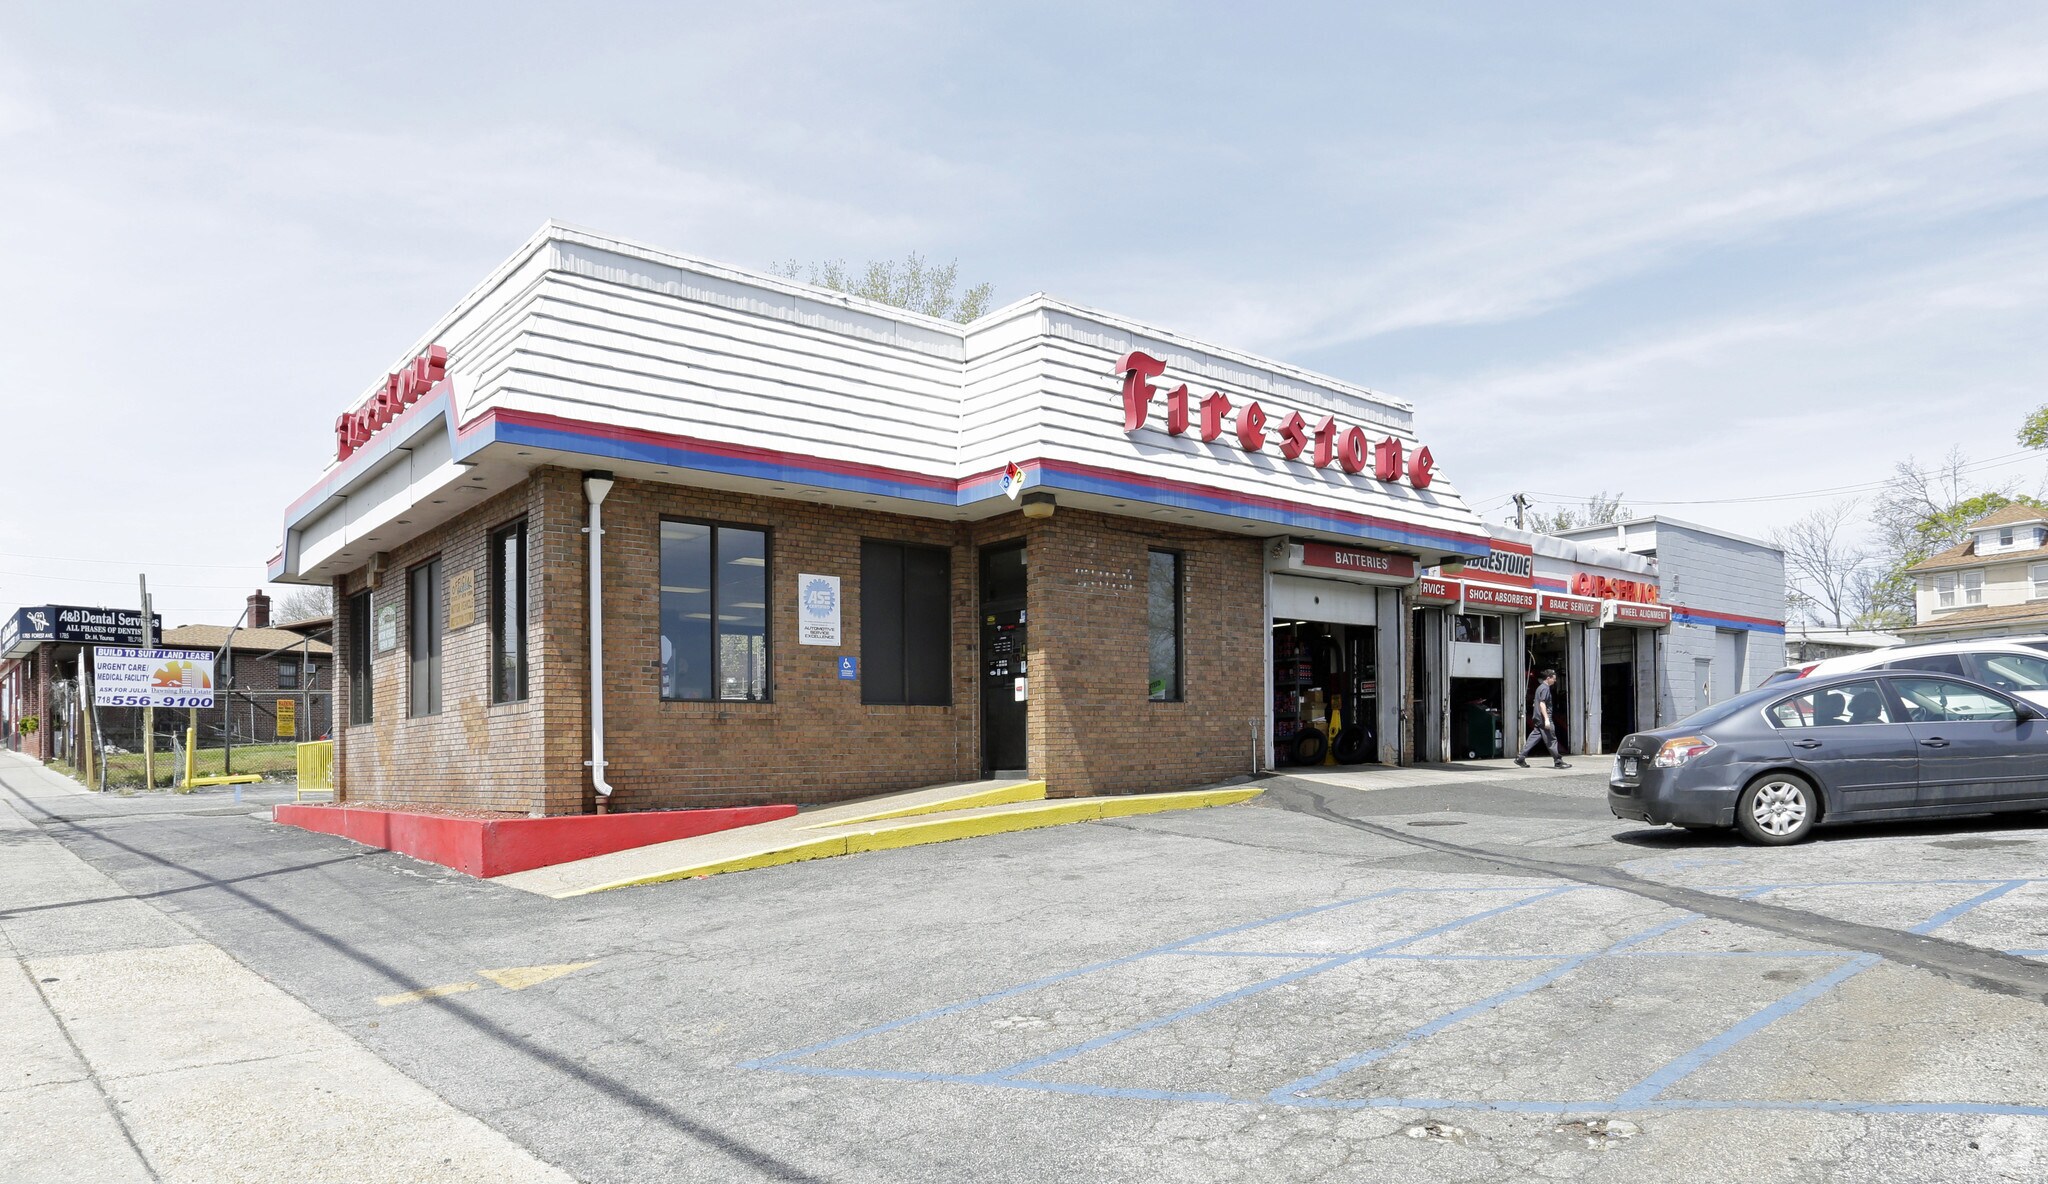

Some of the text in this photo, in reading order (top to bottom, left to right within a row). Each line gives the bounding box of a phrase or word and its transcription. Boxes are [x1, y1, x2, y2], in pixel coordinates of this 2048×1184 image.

[1115, 351, 1434, 489] Firestone
[1008, 464, 1014, 476] 4
[1003, 476, 1010, 488] 3
[1016, 471, 1022, 483] 2
[1335, 551, 1388, 570] BATTERIES
[807, 590, 831, 604] ASE
[1469, 588, 1533, 606] SHOCK ABSORBERS
[1549, 599, 1594, 613] BRAKE SERVICE
[59, 610, 81, 622] A&B
[82, 610, 116, 625] Dental
[1620, 606, 1667, 620] WHEEL ALIGNMENT
[66, 624, 142, 636] ALL PHASES OF DENTIS
[97, 648, 123, 657] BUILD
[124, 649, 136, 657] TO
[162, 651, 184, 660] LAND
[185, 652, 211, 660] LEASE
[97, 662, 126, 671] URGENT
[97, 672, 150, 682] MEDICAL FACILITY
[97, 696, 111, 704] 718
